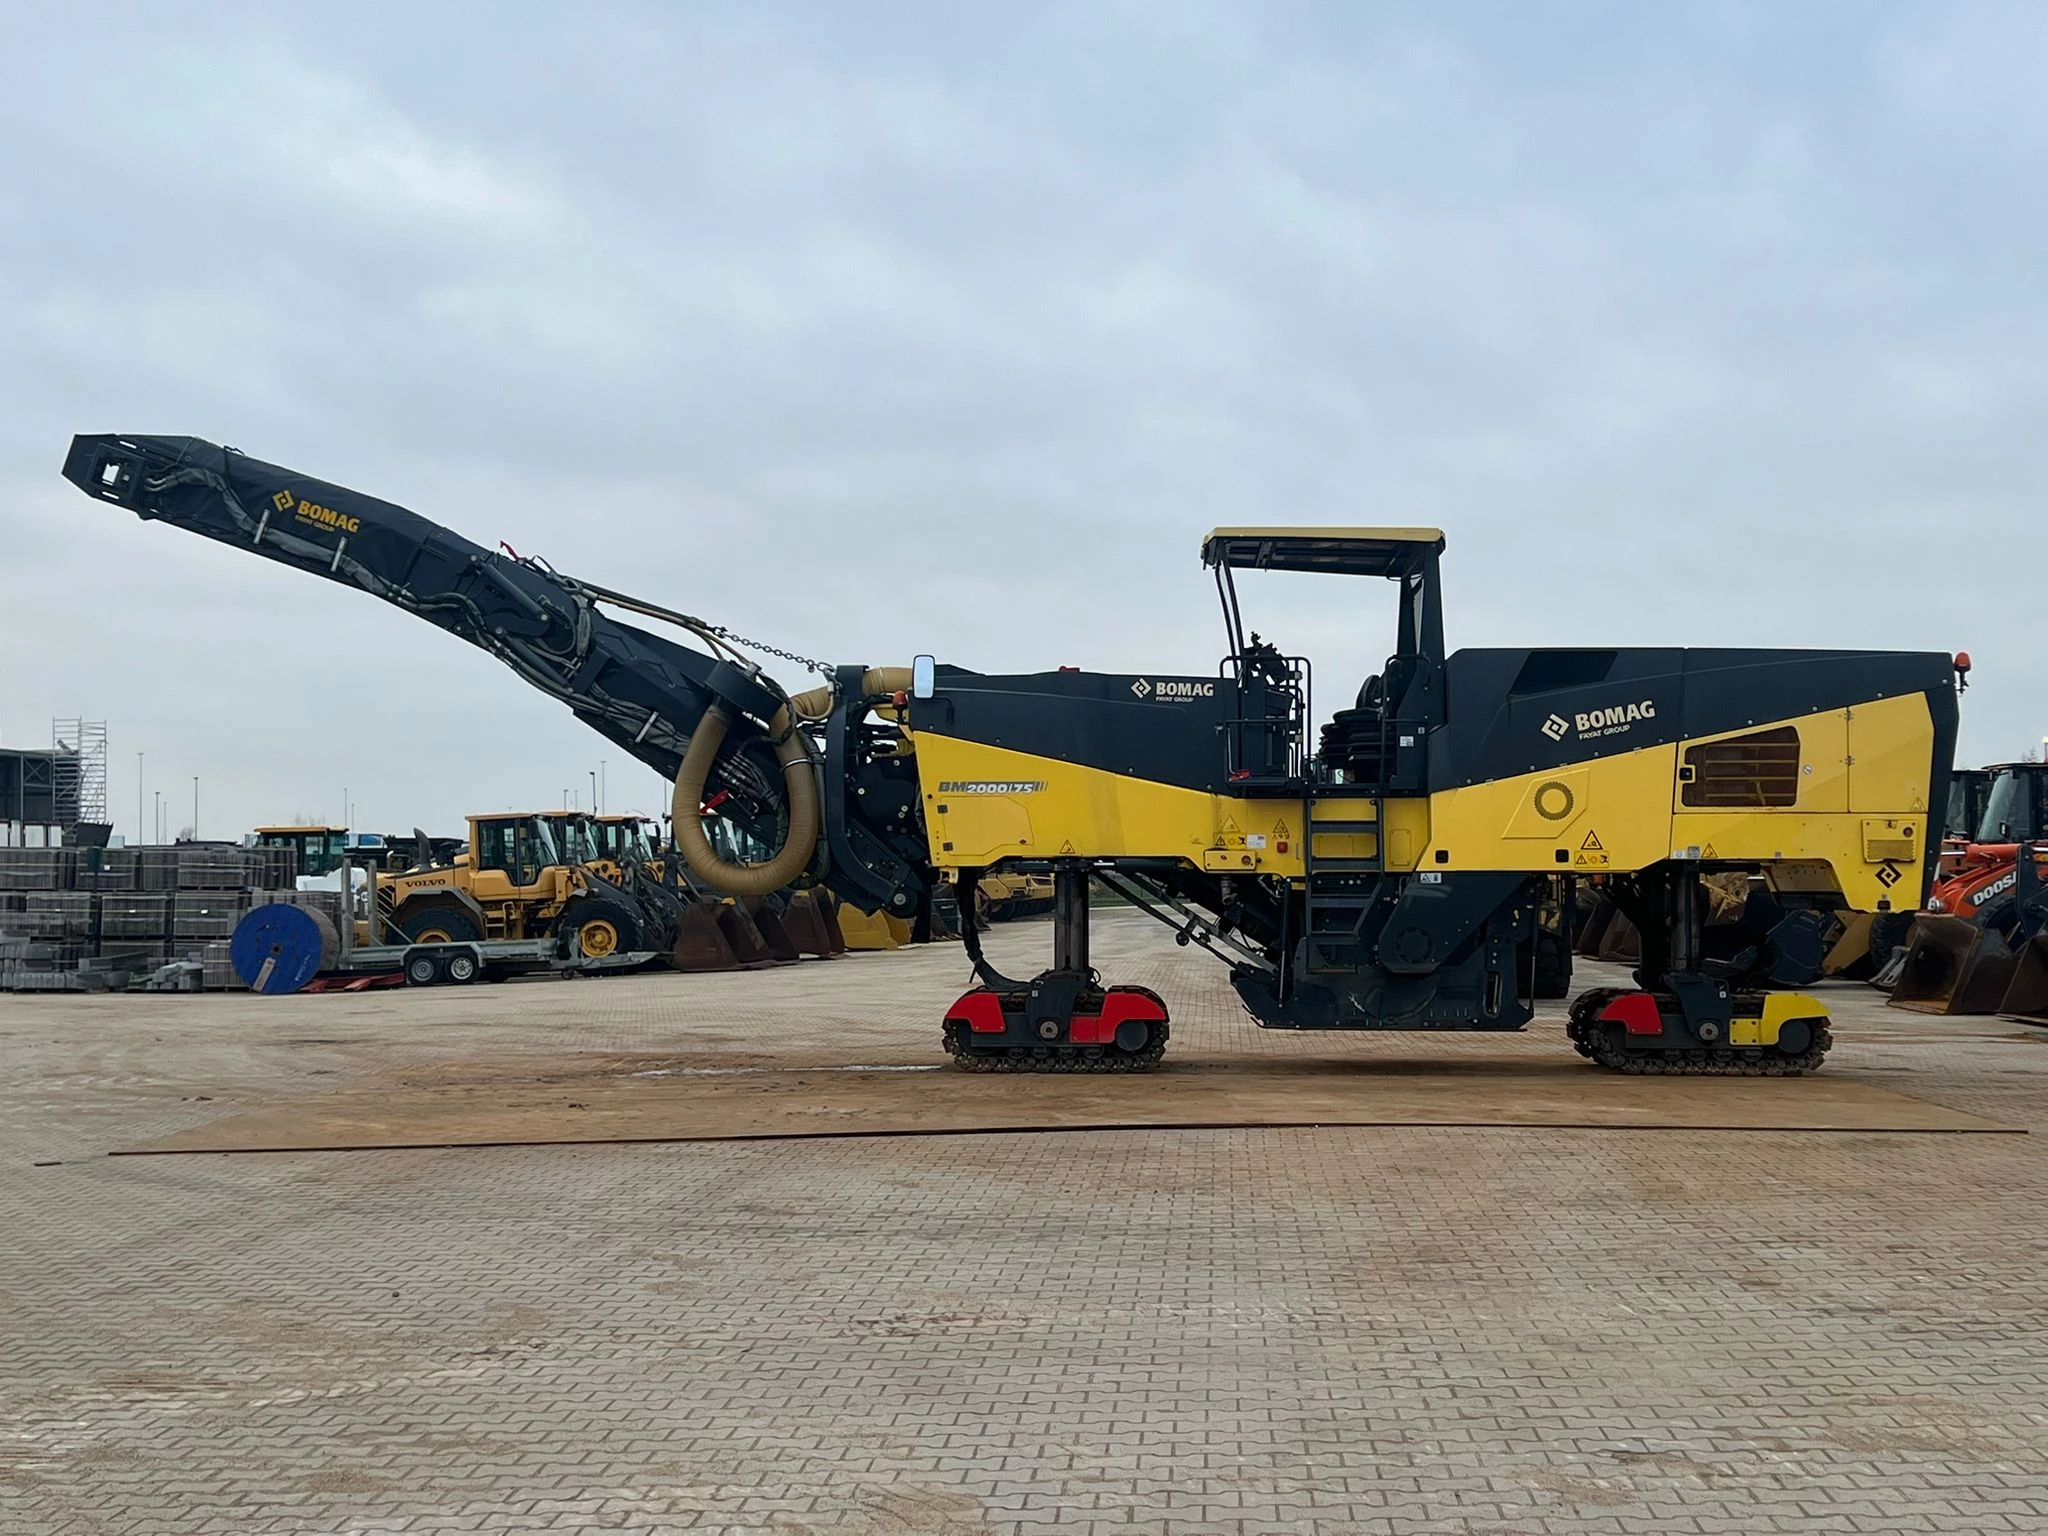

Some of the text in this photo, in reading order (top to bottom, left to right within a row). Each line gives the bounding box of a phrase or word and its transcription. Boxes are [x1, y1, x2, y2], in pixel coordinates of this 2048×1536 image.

[297, 500, 360, 533] BOMAG
[1156, 682, 1214, 697] BOMAG
[1575, 700, 1656, 732] BOMAG
[1579, 724, 1631, 741] FAYAT GROUP
[405, 878, 446, 888] VOLVO
